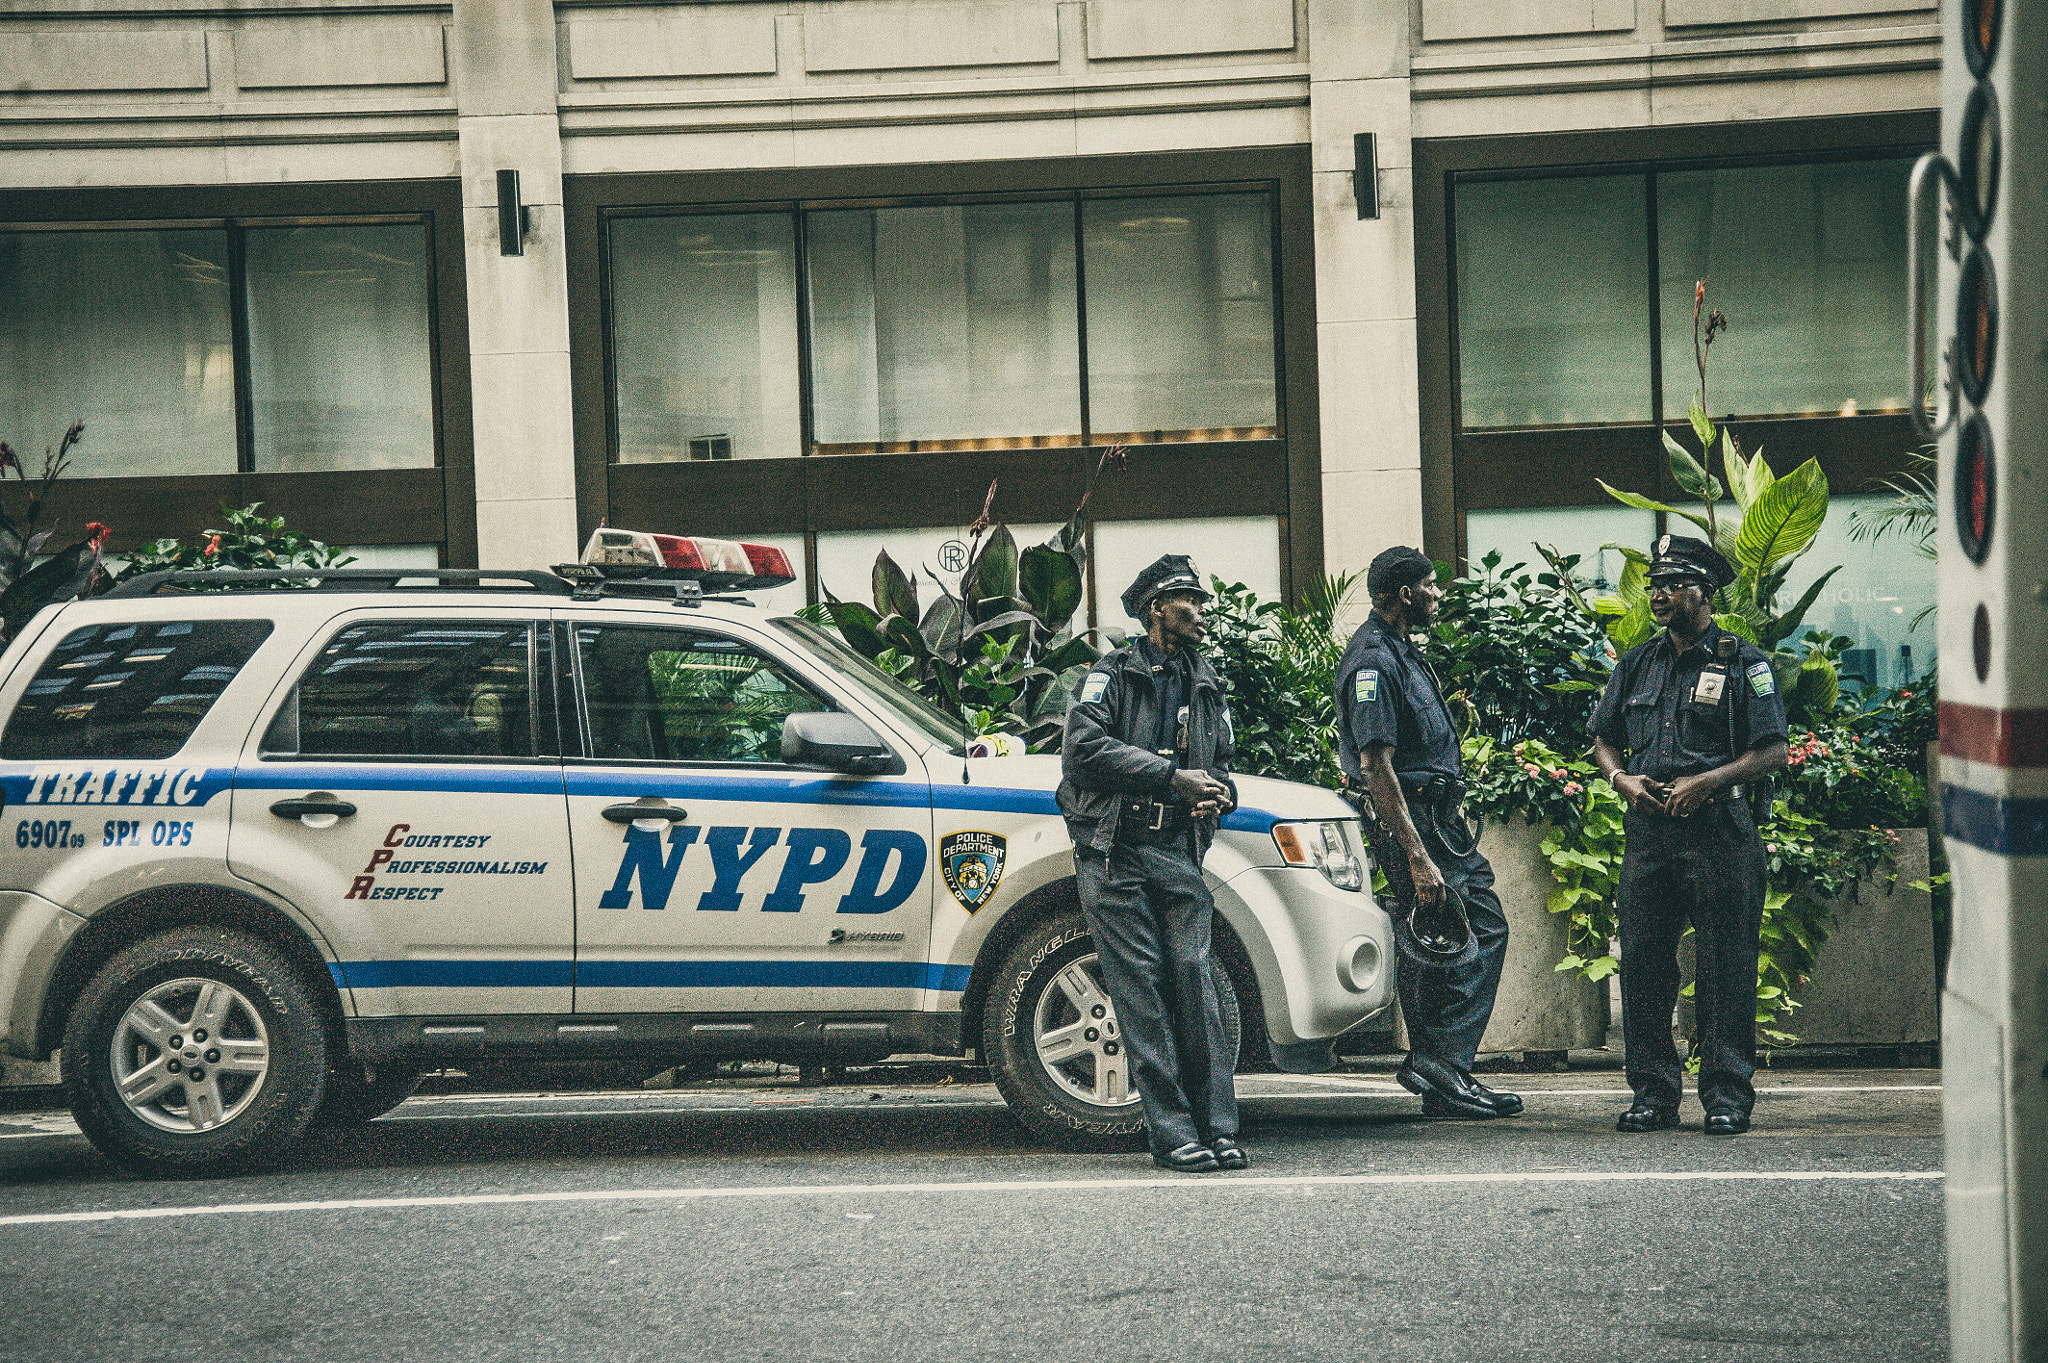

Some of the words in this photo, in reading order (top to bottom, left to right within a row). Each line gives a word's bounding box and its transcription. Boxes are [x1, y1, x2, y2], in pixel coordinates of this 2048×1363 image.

[25, 766, 206, 804] TRAFFIC
[103, 820, 141, 847] SPL
[151, 820, 194, 847] OPS
[943, 842, 1005, 859] DEPARTMENT
[956, 833, 993, 845] POLICE
[598, 825, 928, 914] NYPD
[944, 867, 958, 889] CITY
[954, 890, 966, 901] OF
[977, 885, 993, 905] NEW
[990, 862, 1004, 884] YORK
[1004, 927, 1091, 1037] WRANGL
